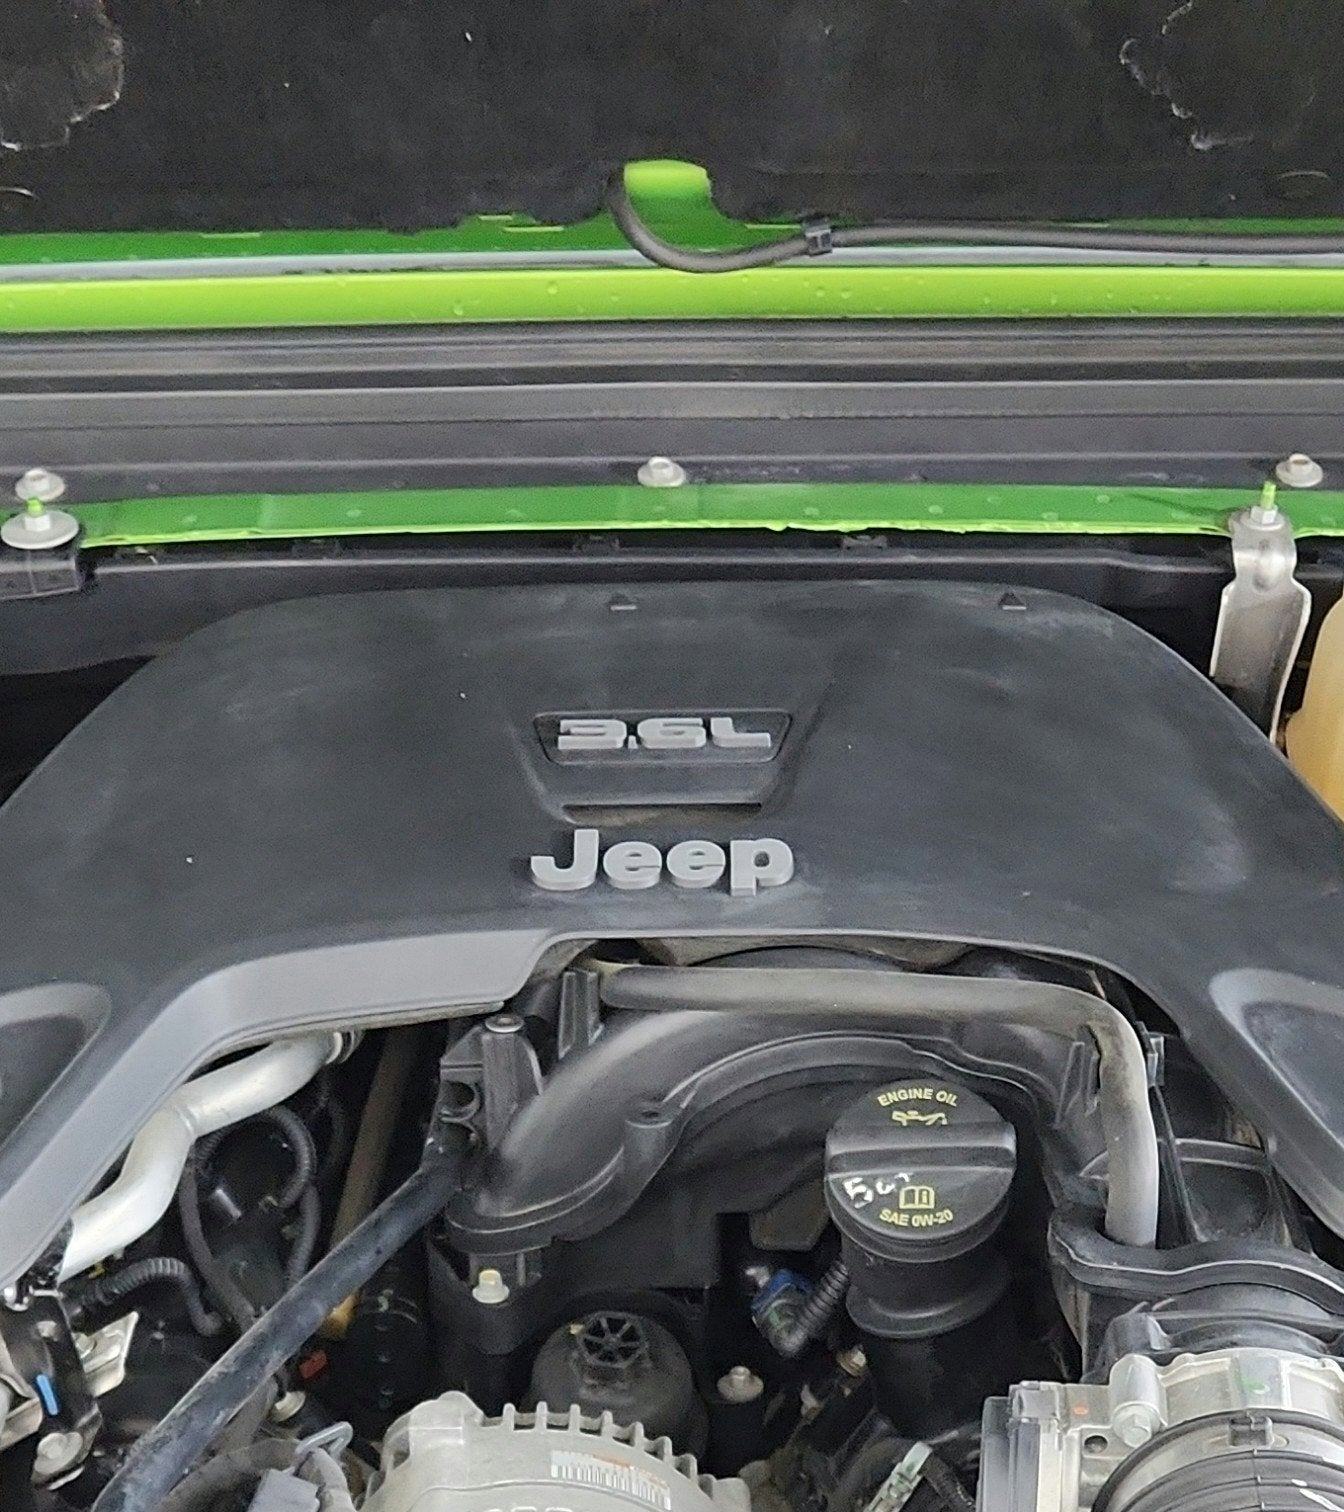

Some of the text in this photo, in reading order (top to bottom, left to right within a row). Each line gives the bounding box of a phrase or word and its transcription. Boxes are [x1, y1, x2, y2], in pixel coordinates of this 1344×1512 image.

[557, 717, 771, 750] 3.6L
[530, 828, 795, 896] Jeep
[877, 1088, 958, 1107] ENGINE OIL
[879, 1208, 954, 1227] SAE 0W-20
